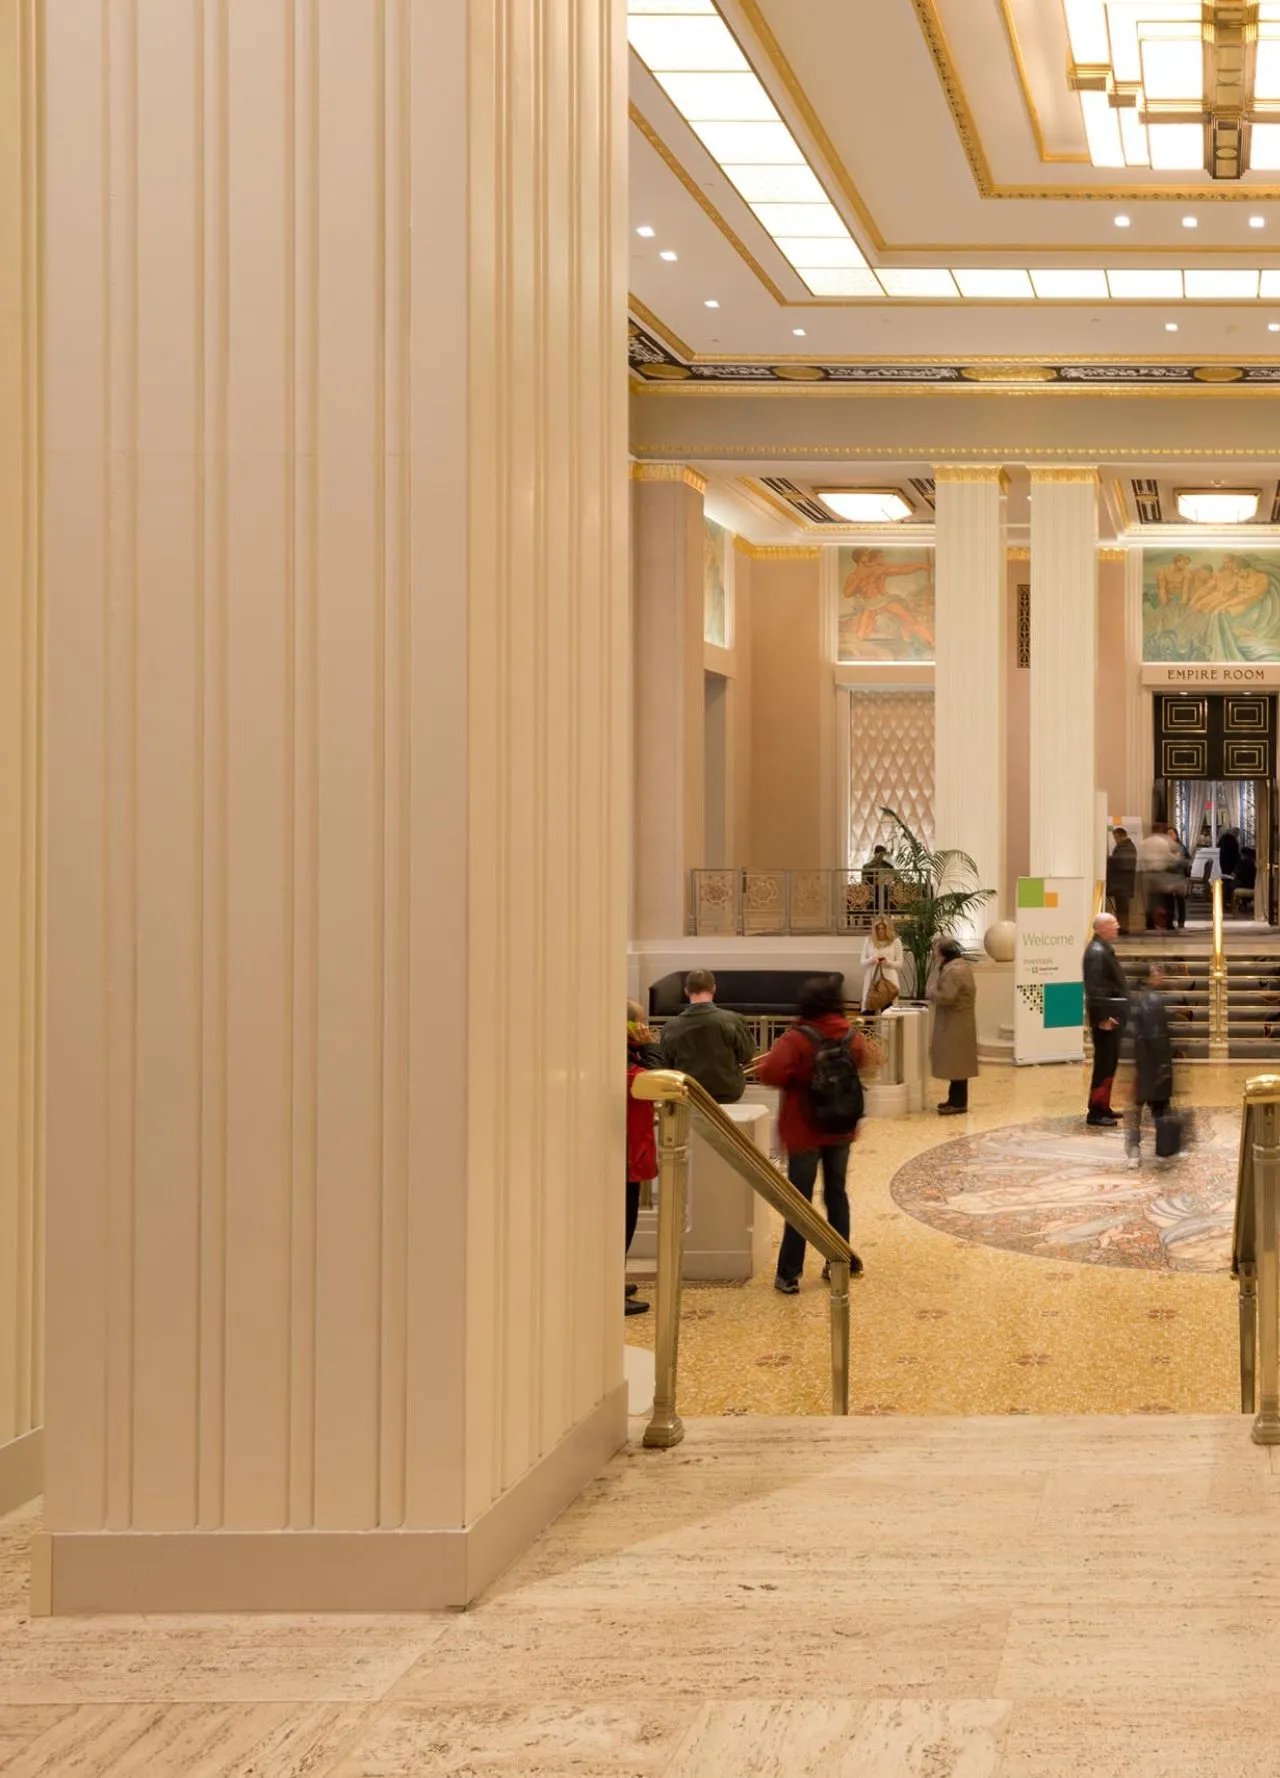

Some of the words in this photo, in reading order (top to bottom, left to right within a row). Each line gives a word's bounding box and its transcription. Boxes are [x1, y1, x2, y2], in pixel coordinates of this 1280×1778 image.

[1167, 669, 1217, 680] EMPIRE
[1223, 669, 1265, 680] ROOM
[1022, 931, 1074, 946] Welcome
